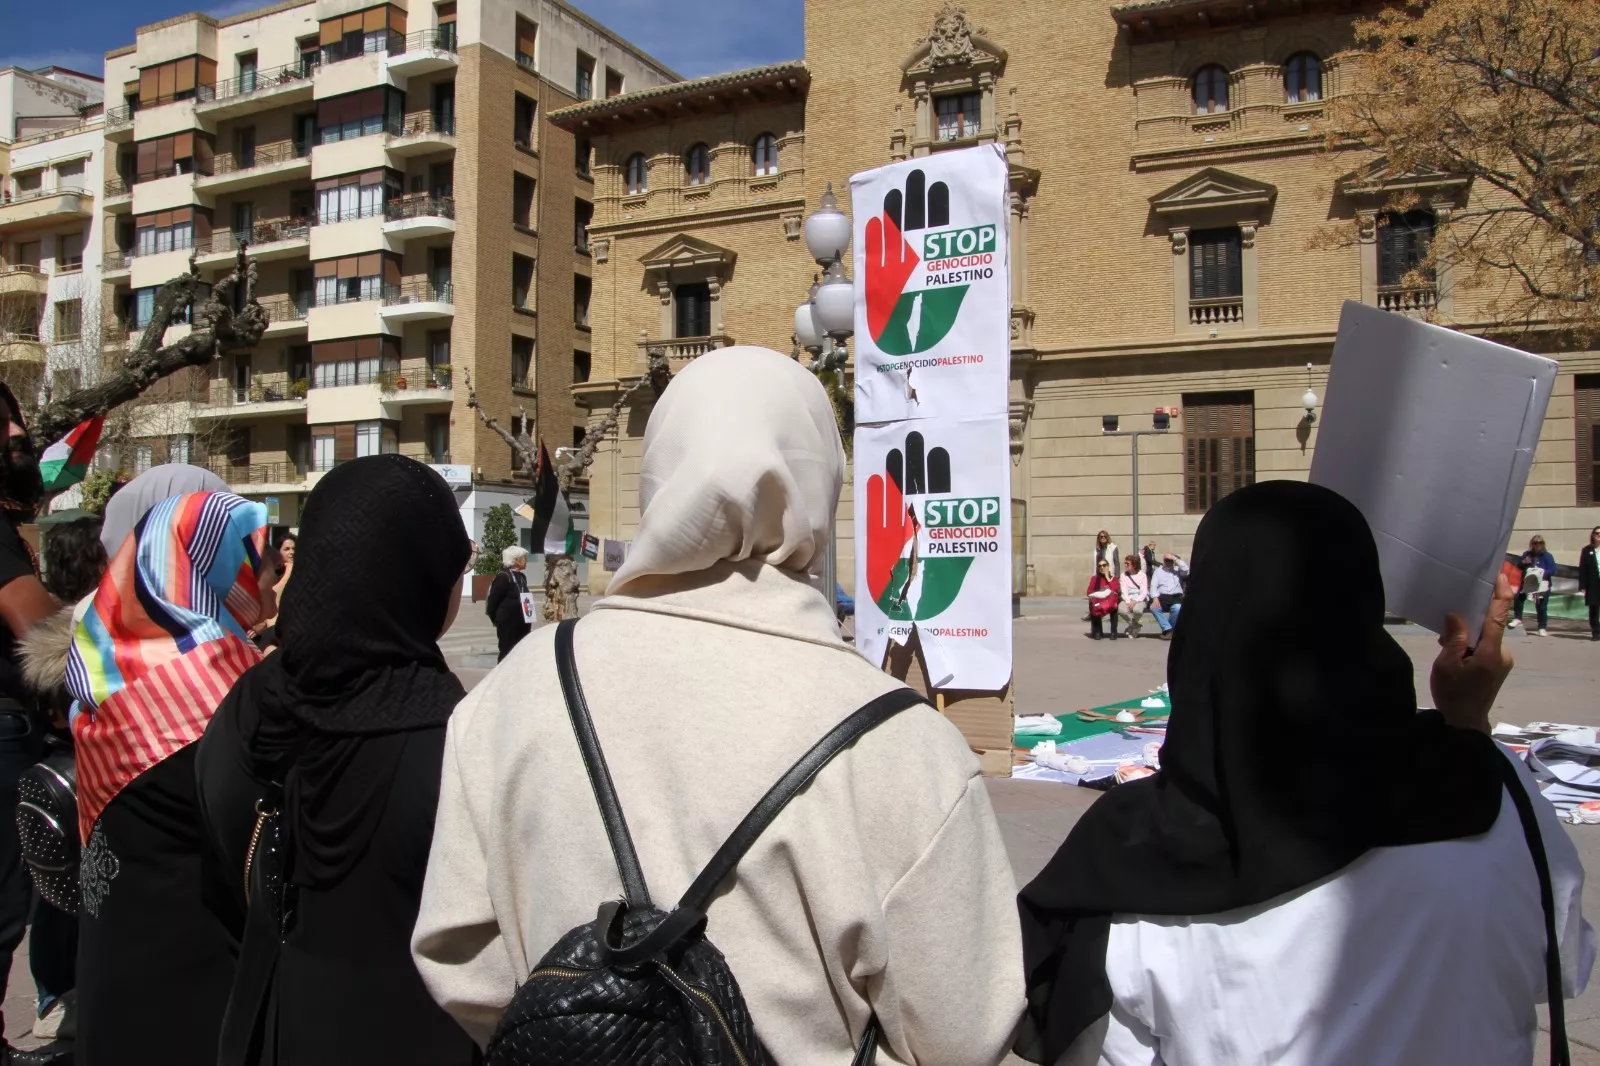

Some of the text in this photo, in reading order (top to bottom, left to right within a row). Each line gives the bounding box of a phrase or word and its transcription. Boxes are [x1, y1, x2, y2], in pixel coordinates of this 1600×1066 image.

[926, 227, 994, 259] STOP
[927, 253, 993, 272] GENOCIDIO
[926, 267, 994, 286] PALESTINO
[926, 498, 999, 526] STOP
[929, 526, 998, 540] GENOCIDIO
[929, 541, 998, 554] PALESTINO
